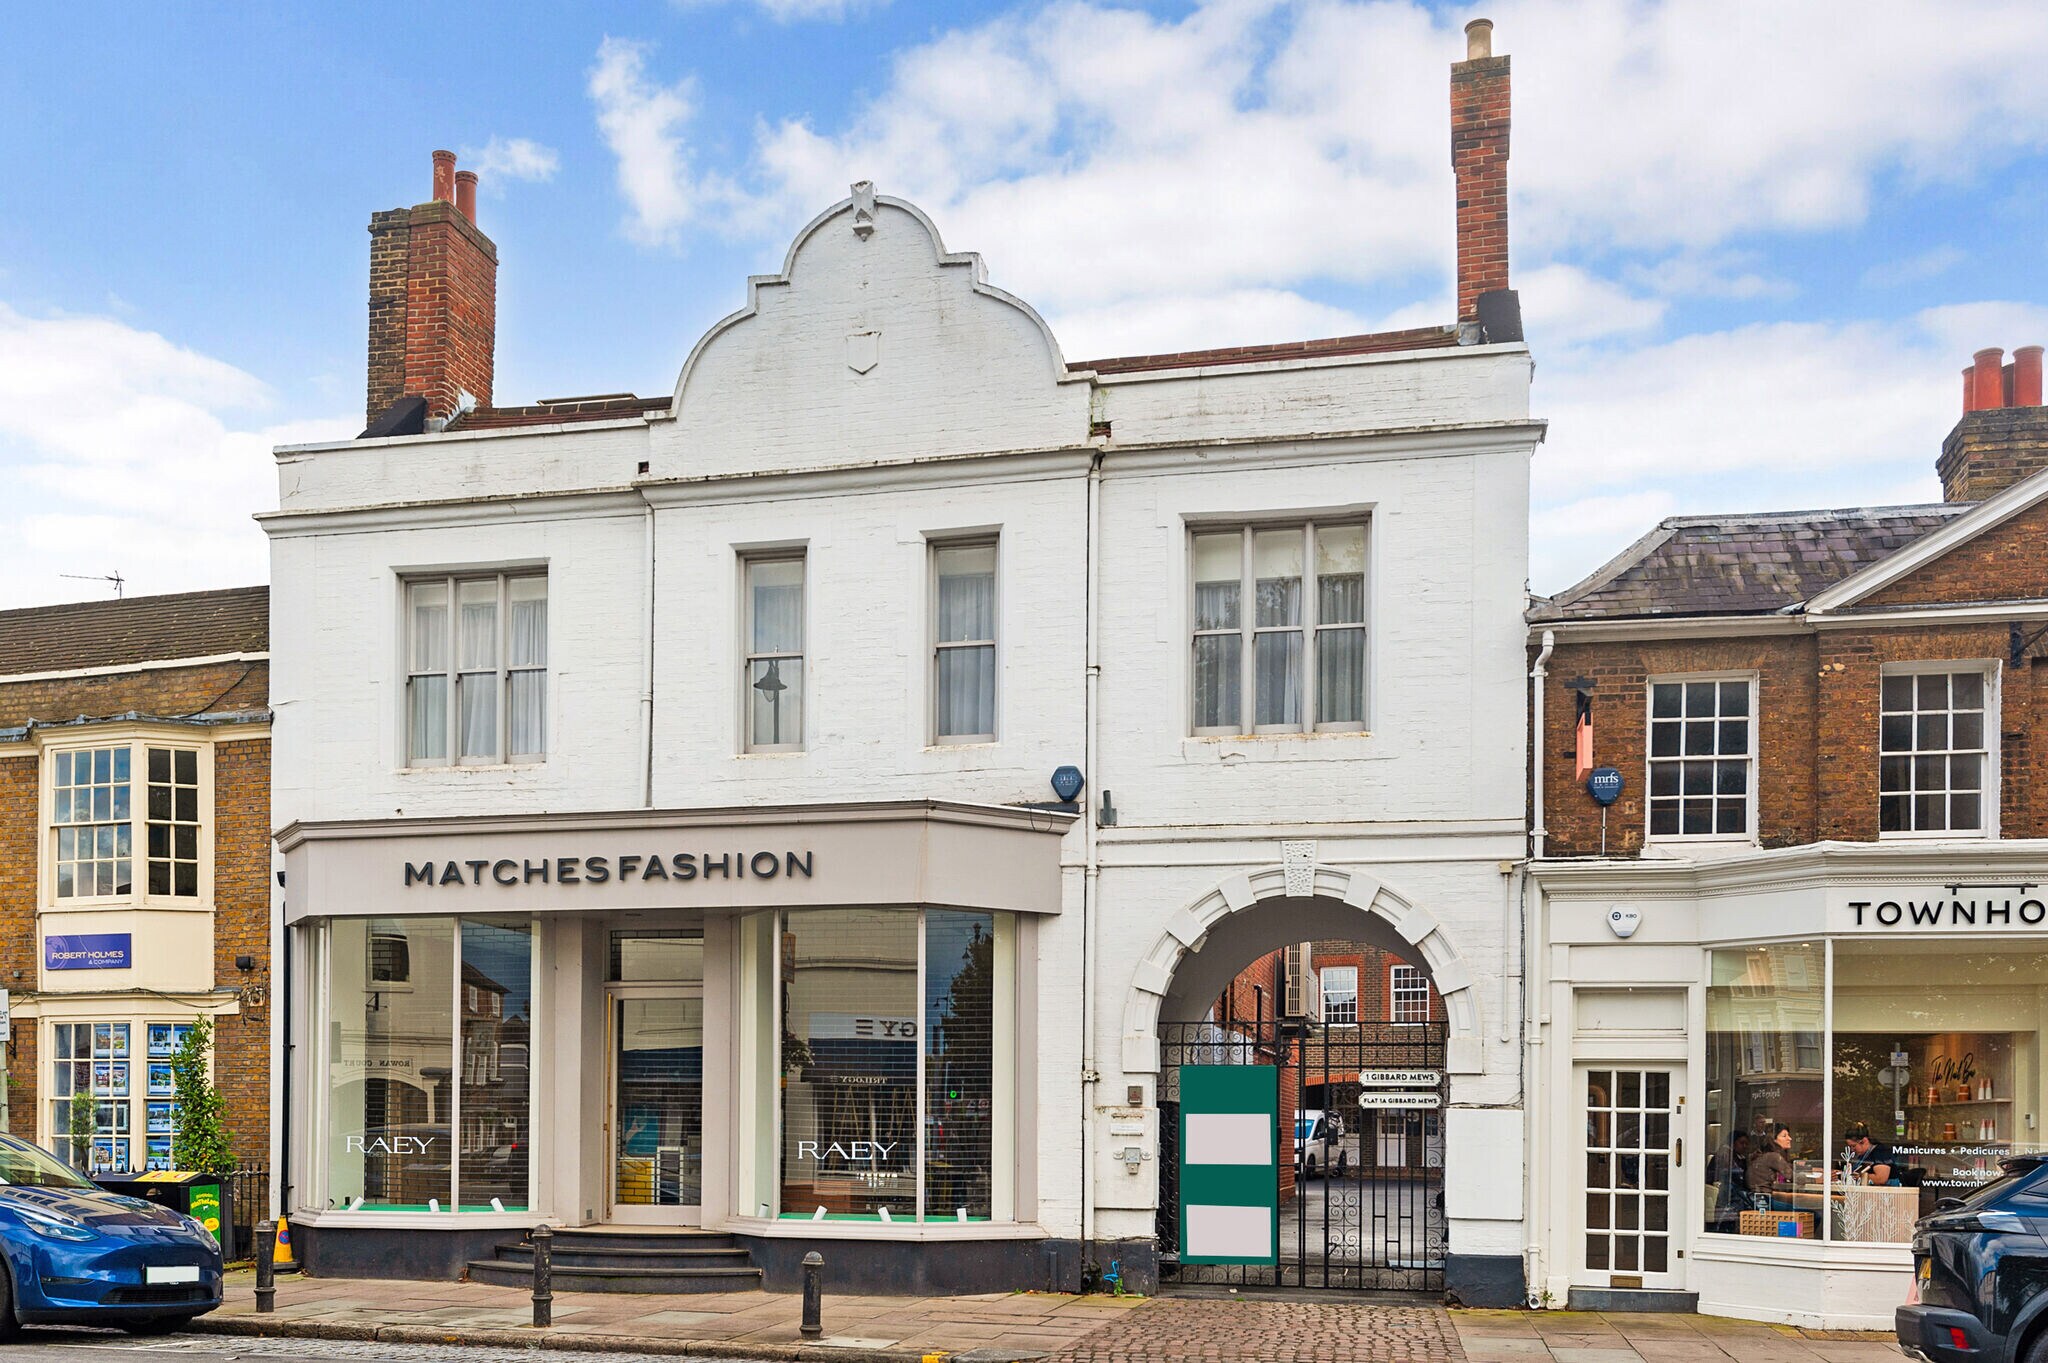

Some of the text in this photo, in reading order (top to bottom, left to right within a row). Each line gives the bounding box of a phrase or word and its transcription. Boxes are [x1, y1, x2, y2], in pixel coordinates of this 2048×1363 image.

[1594, 772, 1619, 783] mrfs
[404, 850, 813, 887] MATCHESFASHION
[1848, 899, 2046, 926] TOWNHO
[52, 951, 124, 960] ROBERT HOLMES
[346, 1135, 435, 1154] RAEY
[798, 1141, 897, 1160] RAEY
[1892, 1146, 1946, 1155] Manicures
[1960, 1146, 2010, 1156] Pedicures
[1952, 1168, 1978, 1177] Book
